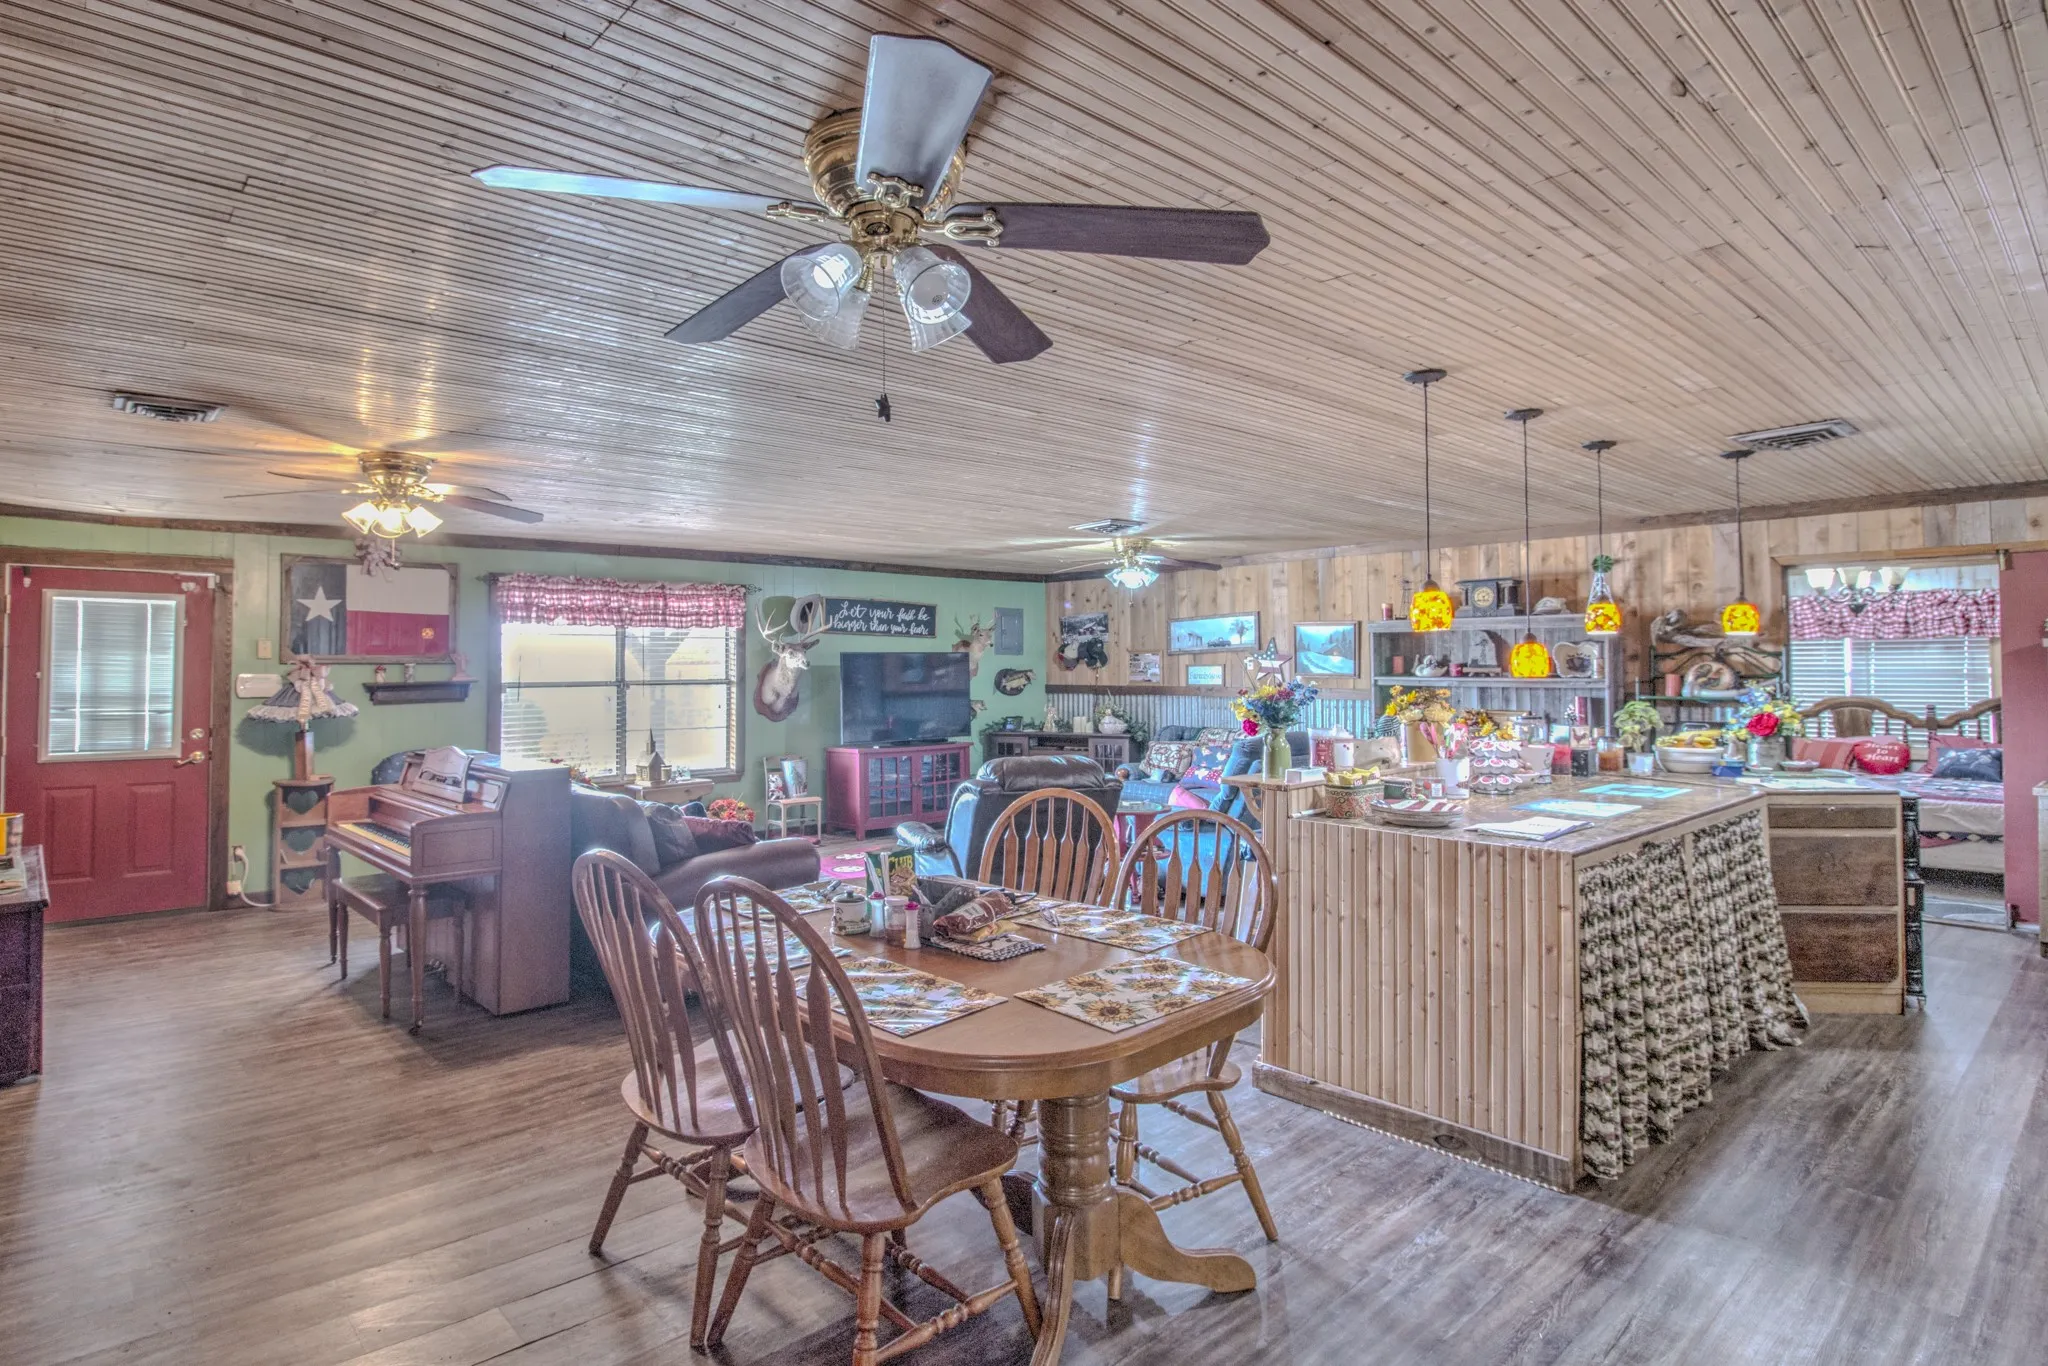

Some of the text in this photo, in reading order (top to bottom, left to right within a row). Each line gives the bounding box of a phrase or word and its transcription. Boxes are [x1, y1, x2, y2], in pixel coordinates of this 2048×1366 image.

[838, 600, 867, 618] Let
[869, 607, 895, 623] your
[917, 607, 931, 621] be
[833, 614, 868, 632] bigger
[890, 623, 908, 634] your
[1864, 754, 1899, 763] Heart
